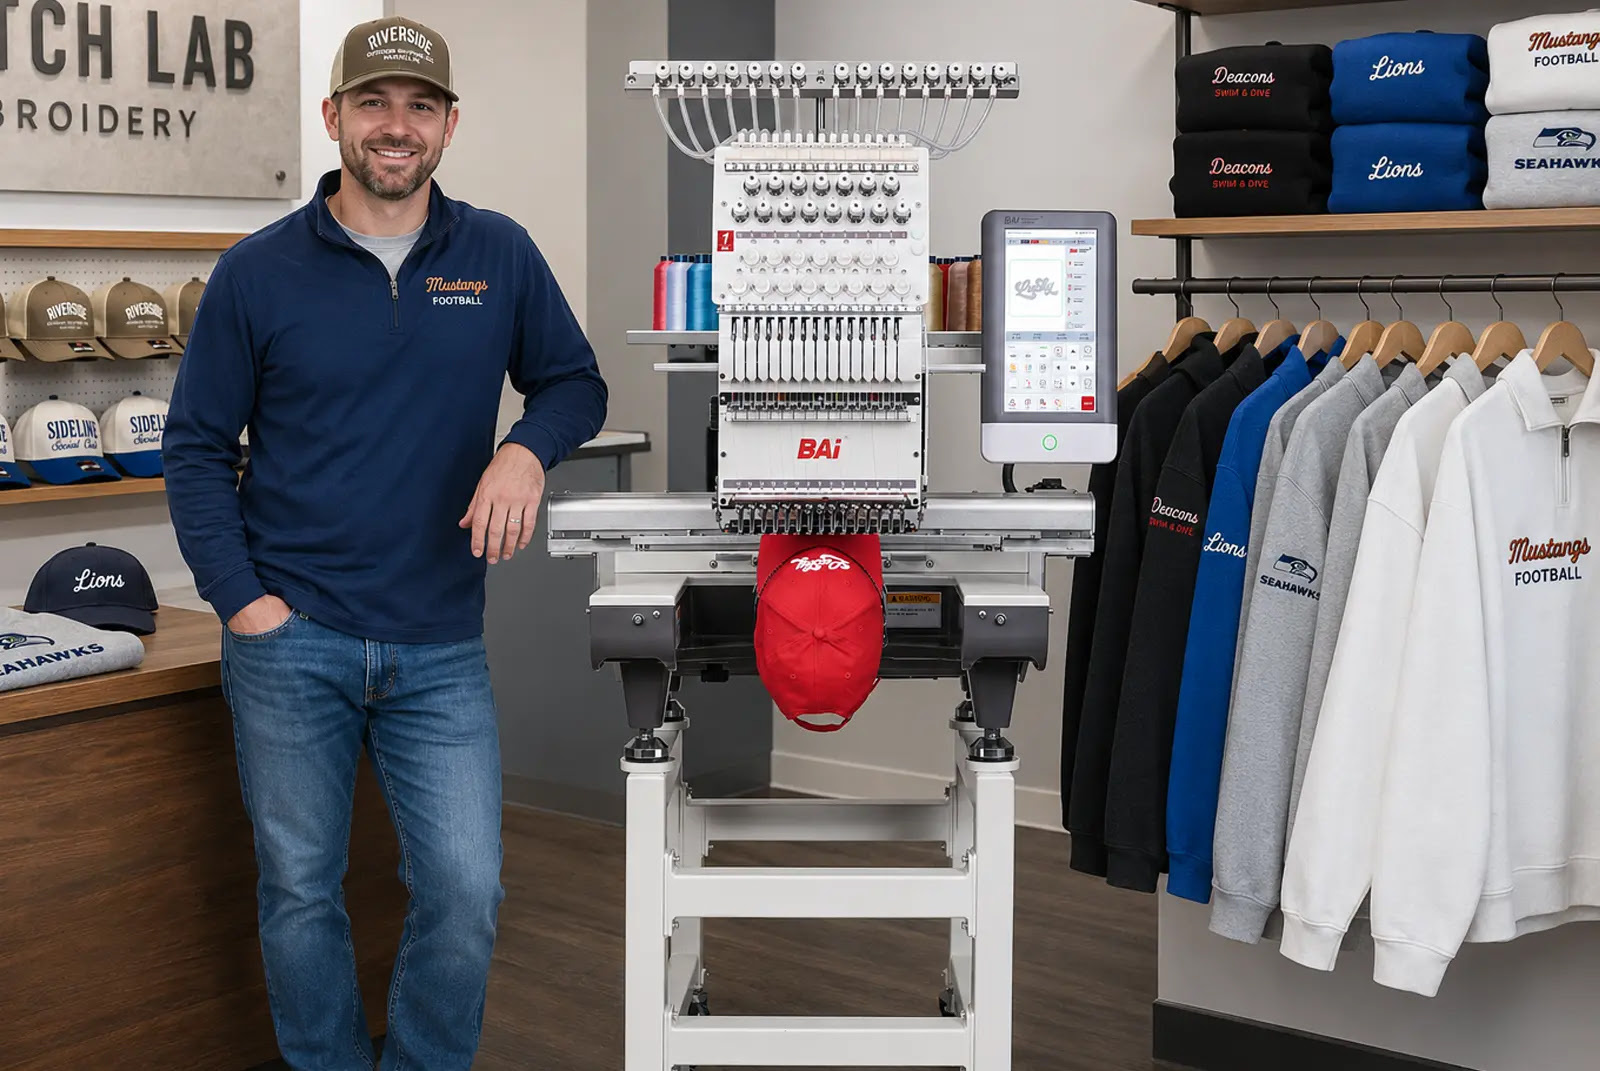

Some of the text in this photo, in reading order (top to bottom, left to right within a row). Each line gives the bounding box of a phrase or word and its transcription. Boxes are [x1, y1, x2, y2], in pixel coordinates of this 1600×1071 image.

[147, 10, 255, 89] LAB
[367, 25, 433, 56] RIVERSIDE
[1369, 55, 1425, 81] Lions
[1534, 52, 1599, 67] FOOTBALL
[1211, 66, 1276, 84] Deacons
[1214, 88, 1239, 97] SWIM
[1250, 88, 1271, 98] DIVE
[0, 99, 197, 138] ROIDERY
[1209, 157, 1273, 174] Deacons
[1368, 155, 1424, 180] Lions
[1212, 179, 1237, 188] SWIM
[1248, 179, 1269, 189] DIVE
[425, 276, 489, 296] Mustangs
[46, 301, 87, 321] RIVERSIDE
[432, 296, 483, 306] FOOTBALL
[47, 419, 98, 440] SIDELINE
[52, 439, 80, 451] Social
[1151, 496, 1199, 524] Deacons
[1203, 532, 1248, 558] Lions
[1508, 537, 1591, 565] Mustangs
[73, 568, 125, 593] Lions
[1514, 566, 1582, 586] FOOTBALL
